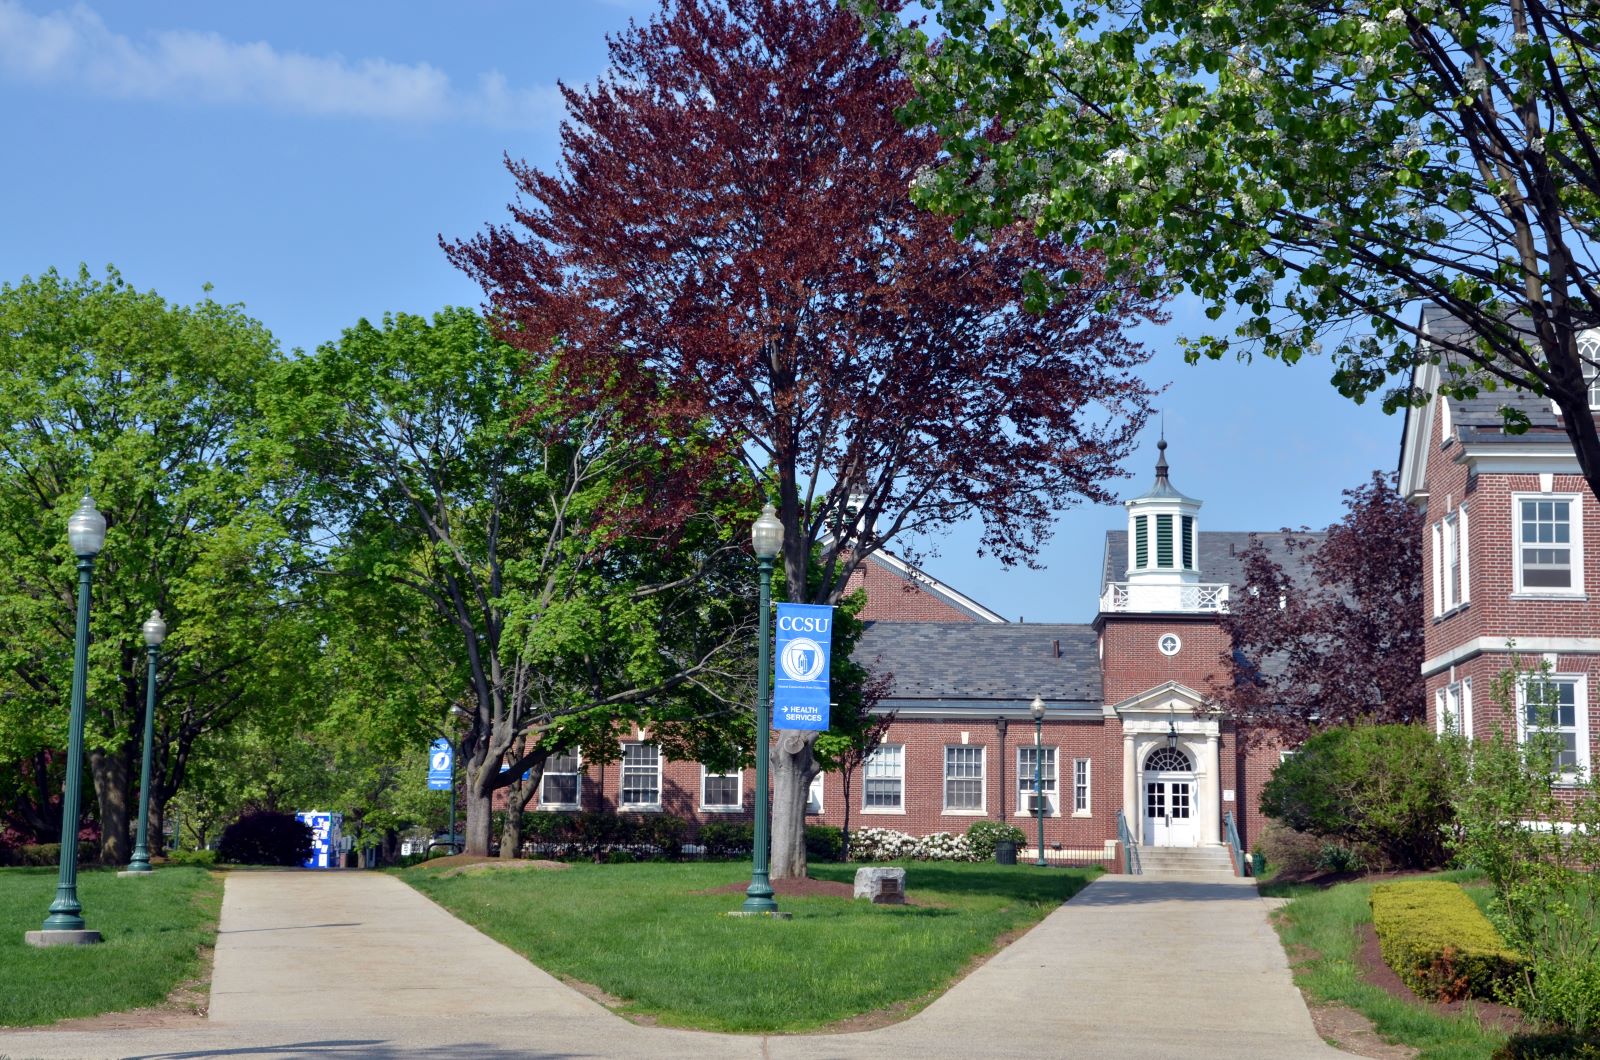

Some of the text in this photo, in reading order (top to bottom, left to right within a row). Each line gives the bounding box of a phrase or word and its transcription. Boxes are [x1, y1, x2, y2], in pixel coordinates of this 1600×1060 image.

[779, 616, 829, 633] CCSU
[790, 706, 818, 714] HEALTH
[785, 713, 822, 722] SERVICES
